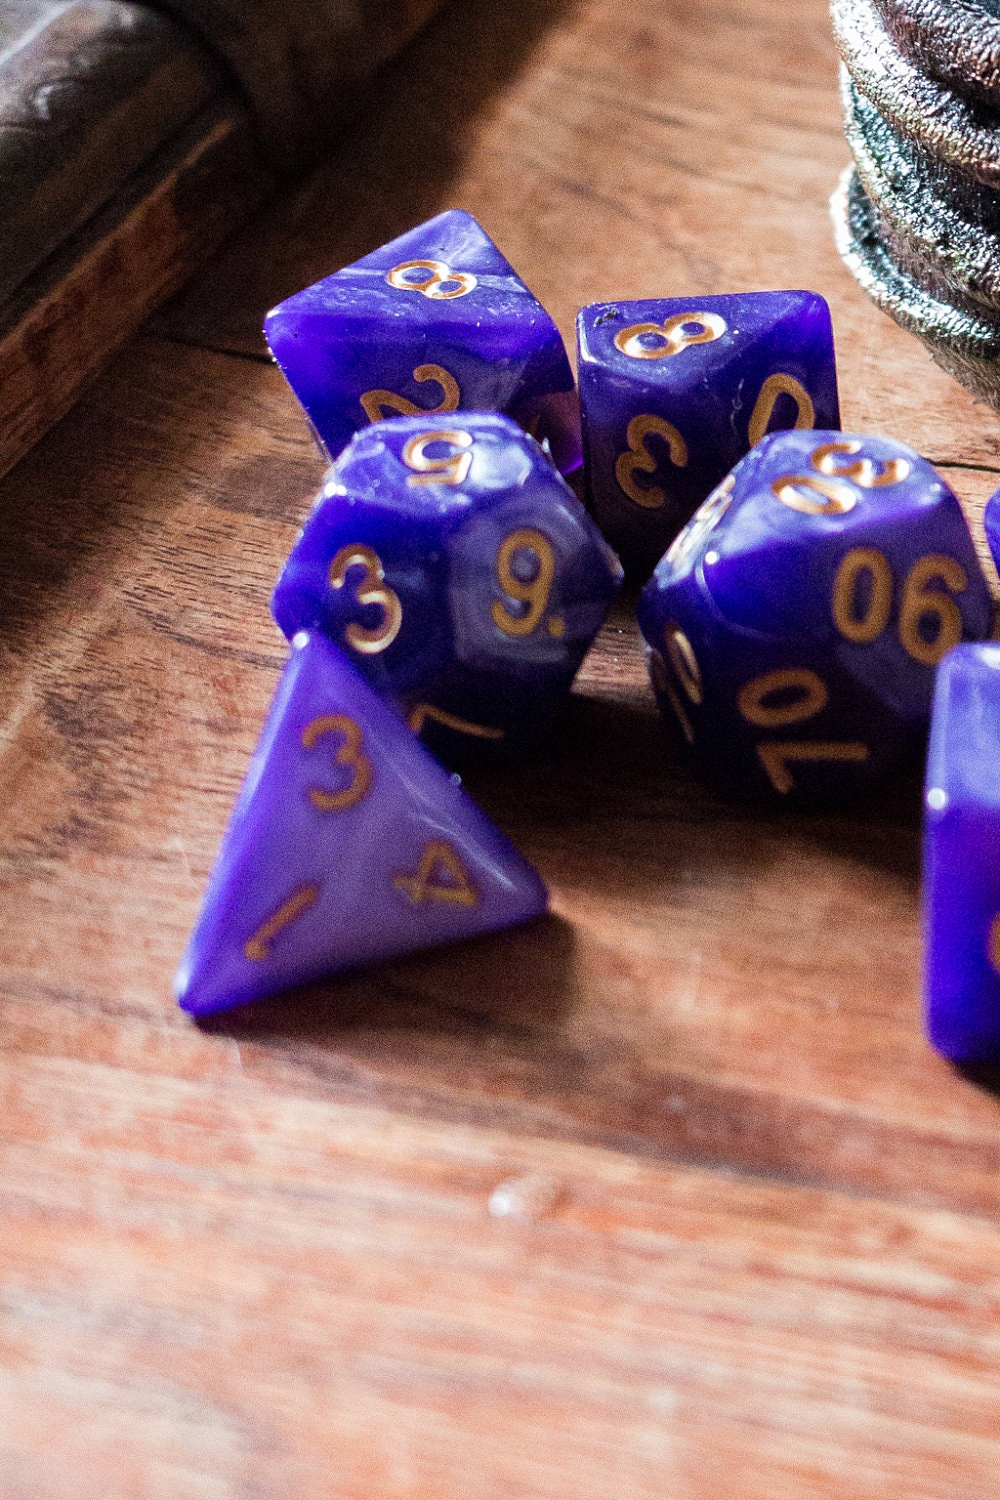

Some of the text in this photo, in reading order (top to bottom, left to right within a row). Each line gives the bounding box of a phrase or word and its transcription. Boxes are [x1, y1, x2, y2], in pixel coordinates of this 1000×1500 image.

[385, 260, 478, 299] 8
[613, 311, 727, 360] 8
[402, 430, 474, 488] 5
[614, 413, 688, 509] 3
[328, 542, 402, 654] 3
[301, 713, 375, 812] 3
[391, 840, 480, 906] 4
[243, 884, 321, 960] 1
